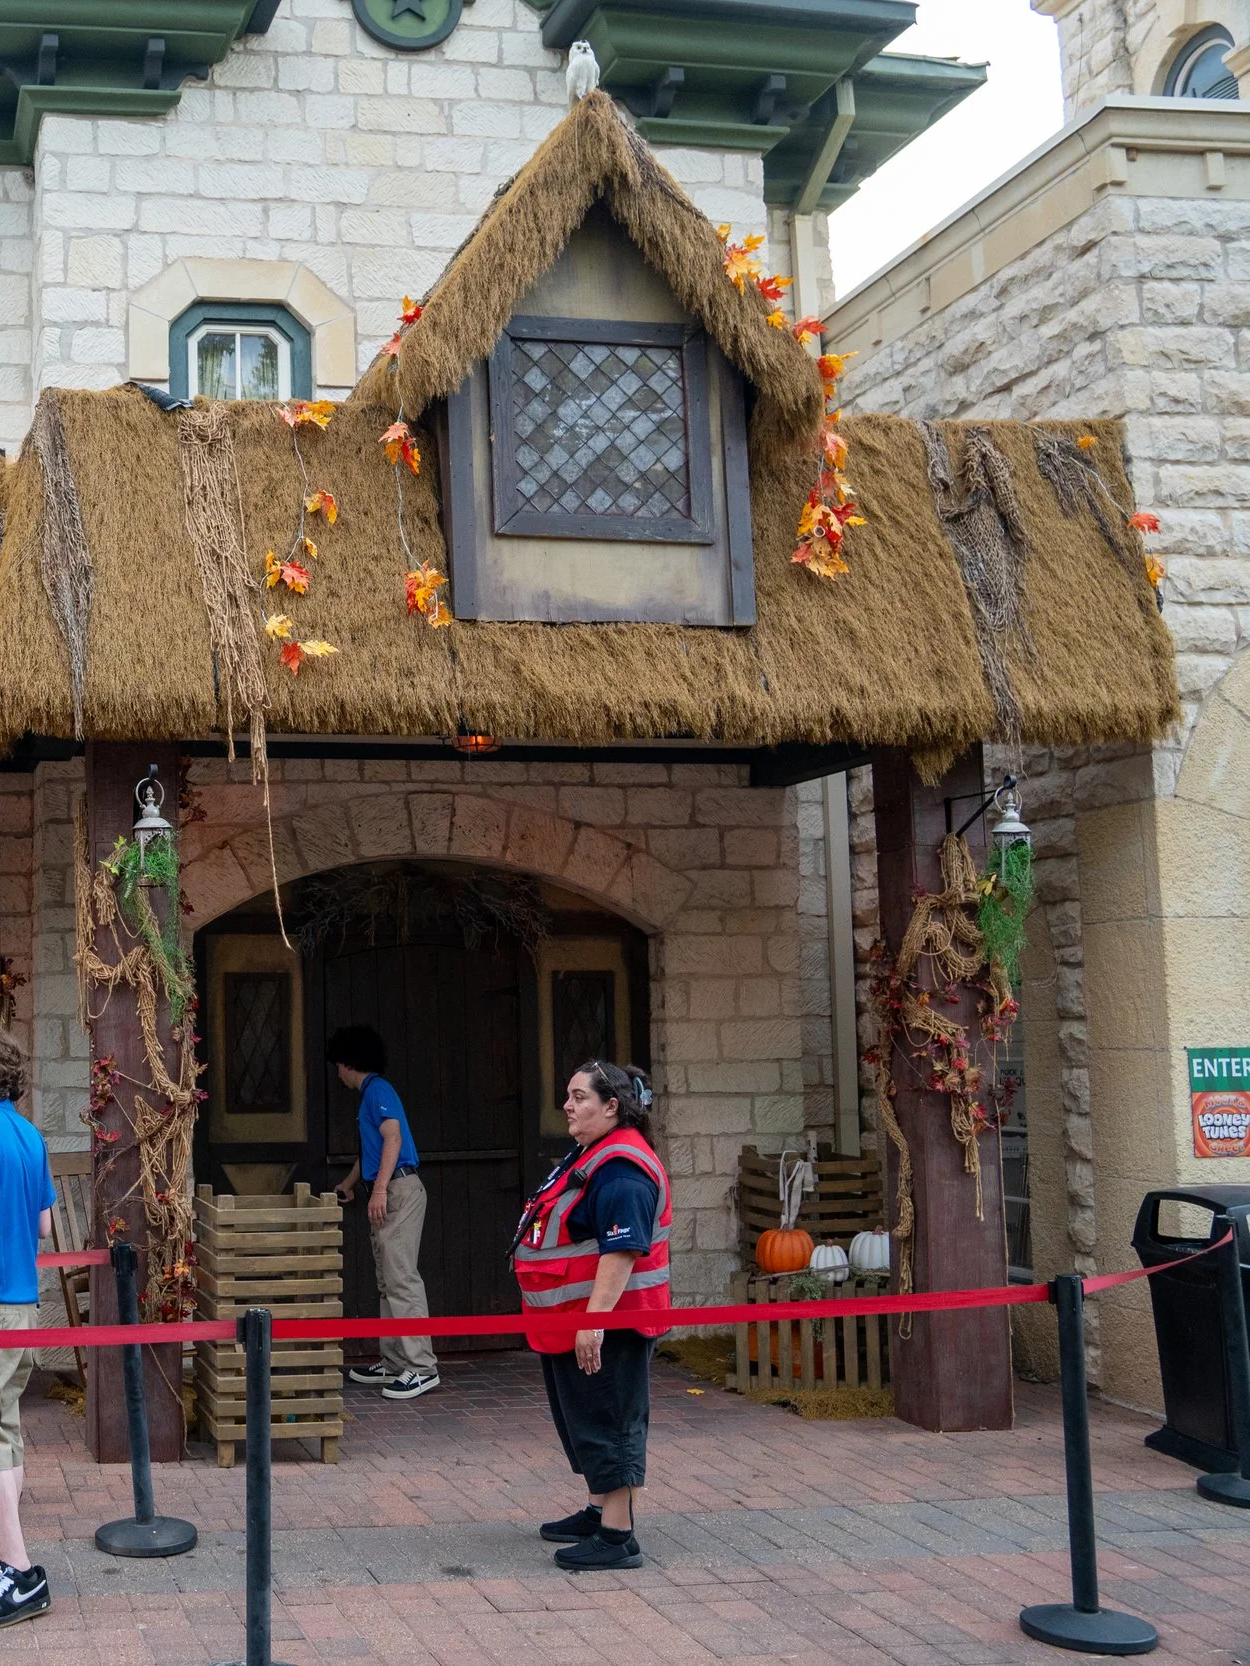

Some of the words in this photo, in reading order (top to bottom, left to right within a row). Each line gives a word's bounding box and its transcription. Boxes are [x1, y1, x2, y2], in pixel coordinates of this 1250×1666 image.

[1192, 1057, 1250, 1078] ENTER
[1198, 1112, 1250, 1128] LOONEY
[1203, 1125, 1247, 1140] TUNES
